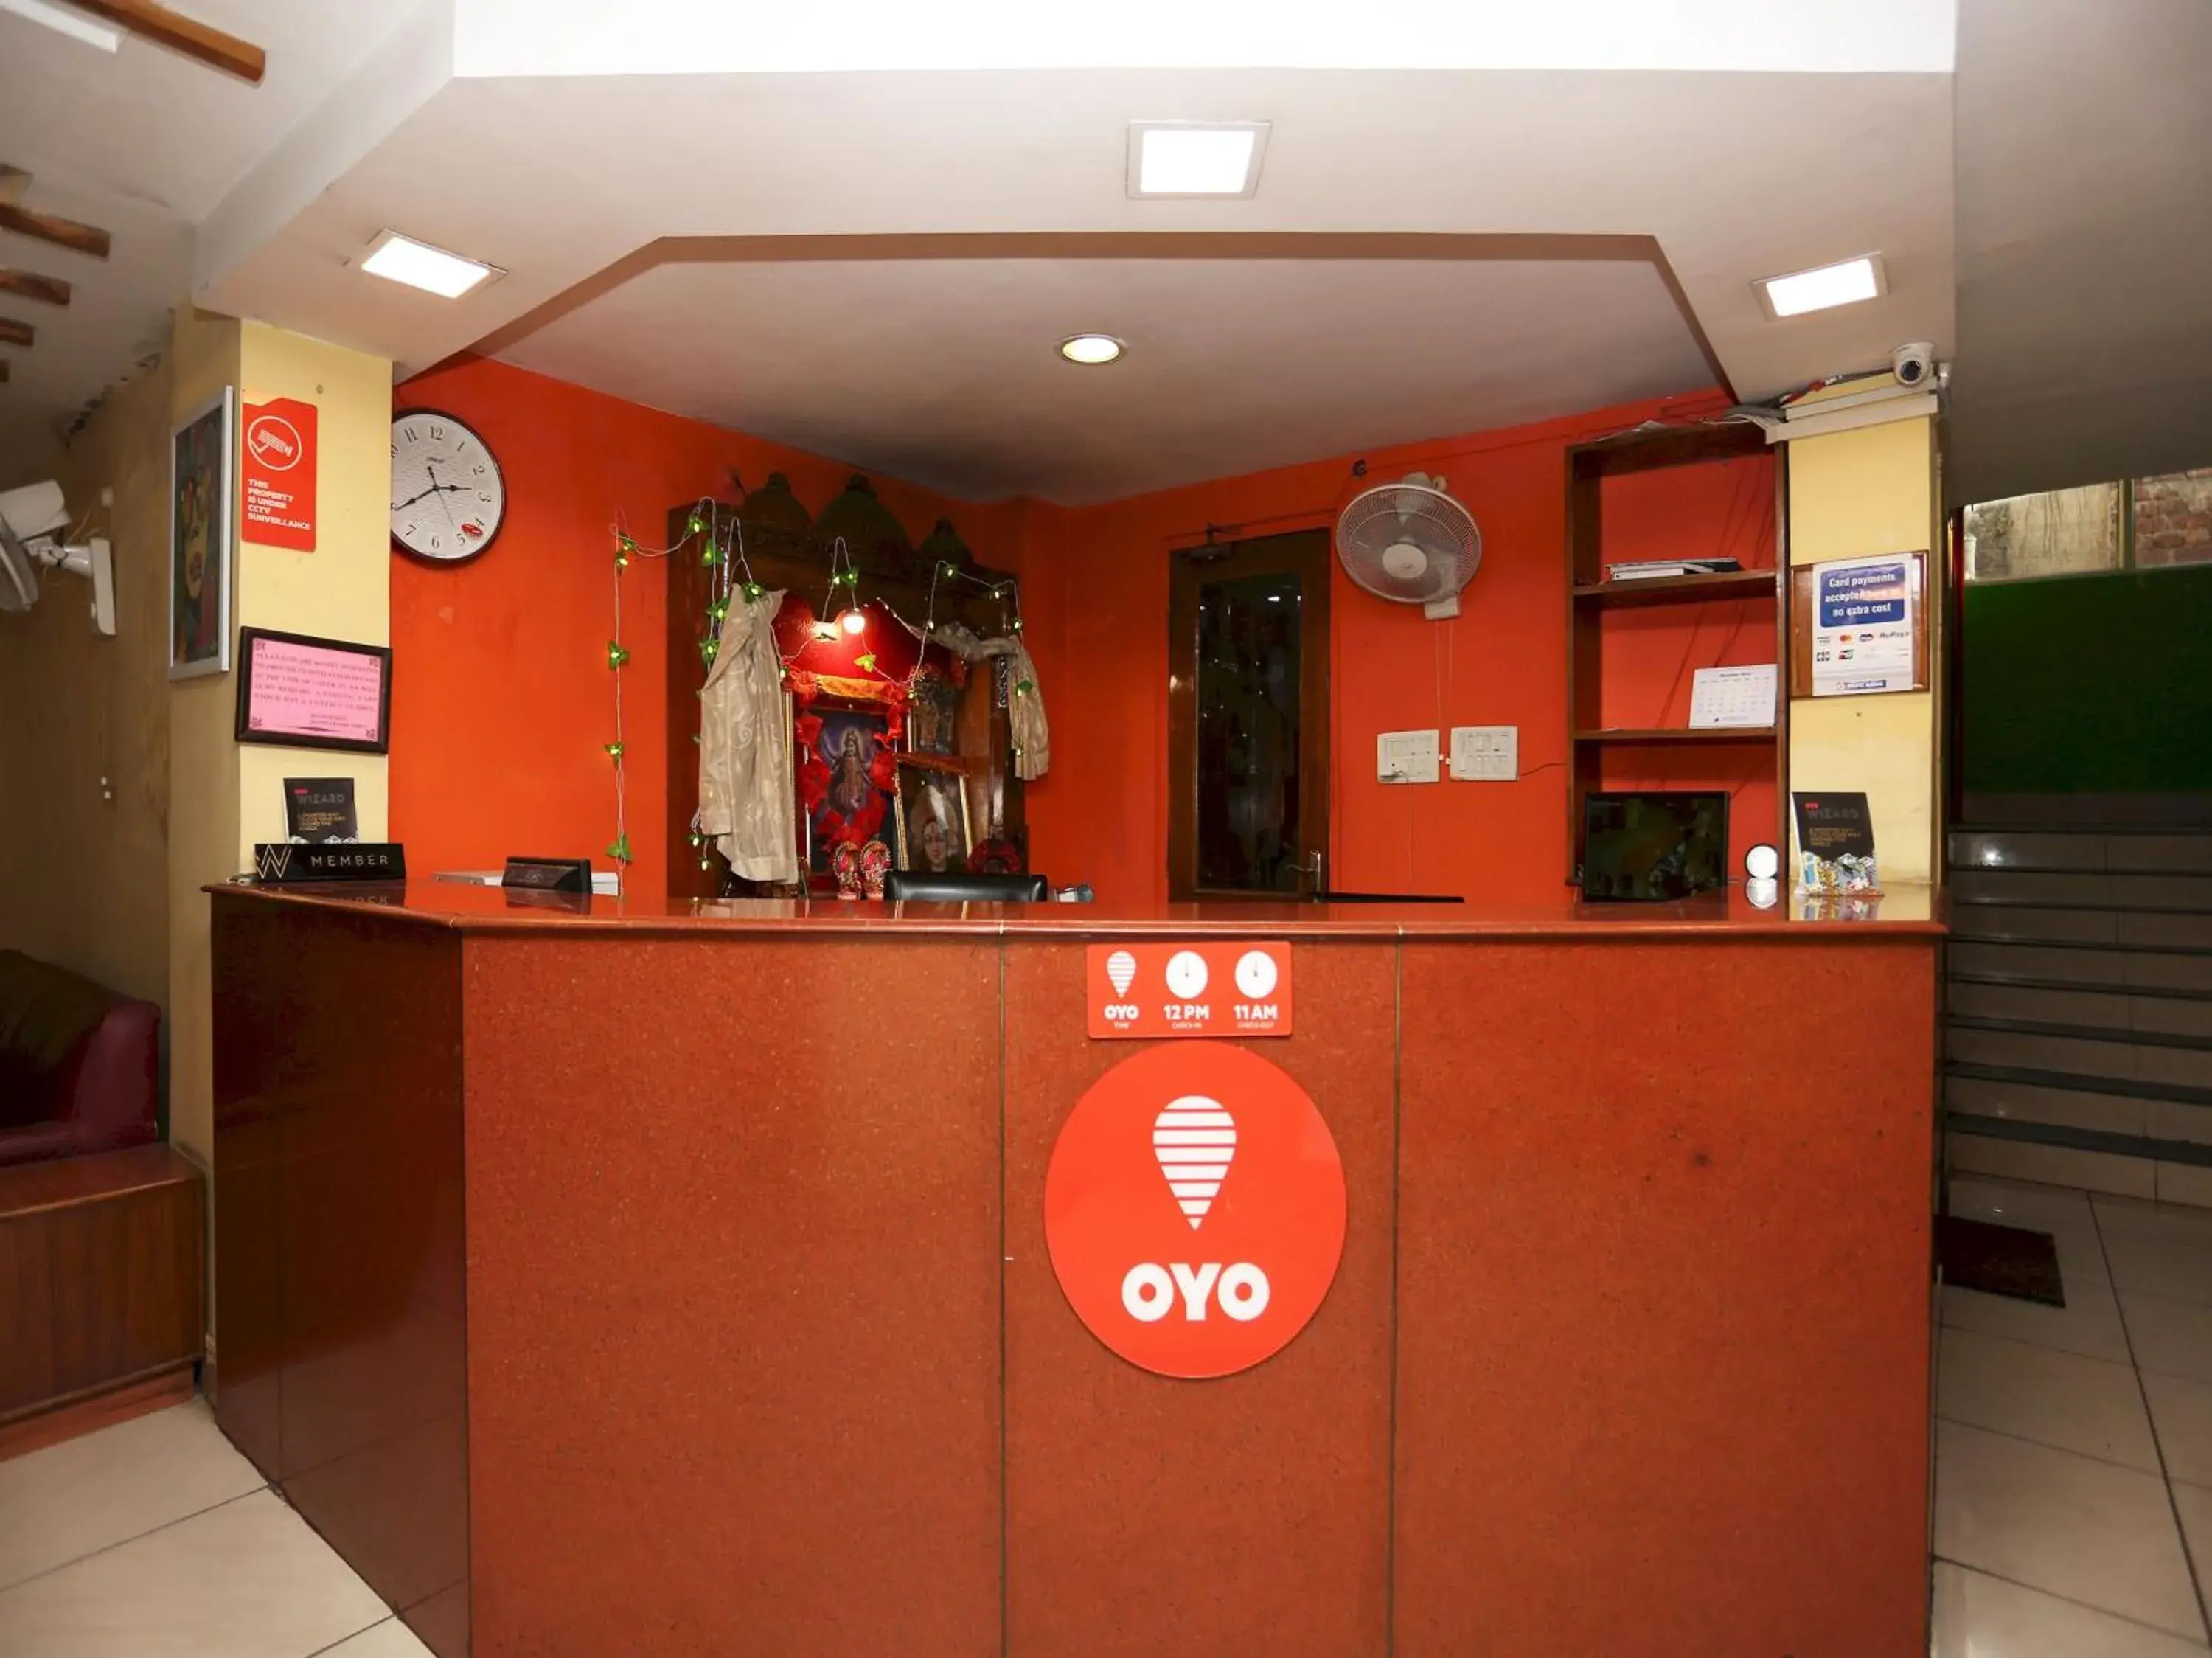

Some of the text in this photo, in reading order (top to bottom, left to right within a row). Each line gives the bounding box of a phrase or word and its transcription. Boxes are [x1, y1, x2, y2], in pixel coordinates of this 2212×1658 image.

[404, 427, 418, 443] 11
[430, 426, 443, 440] 12
[431, 537, 440, 549] 6
[1829, 573, 1896, 588] Card payments
[1832, 603, 1891, 617] no extra cost
[310, 855, 389, 867] MEMBER
[1105, 1005, 1139, 1020] OYO
[1164, 1005, 1209, 1020] 12 PM
[1234, 1004, 1278, 1020] 11 AM
[1121, 1262, 1270, 1322] OYO
